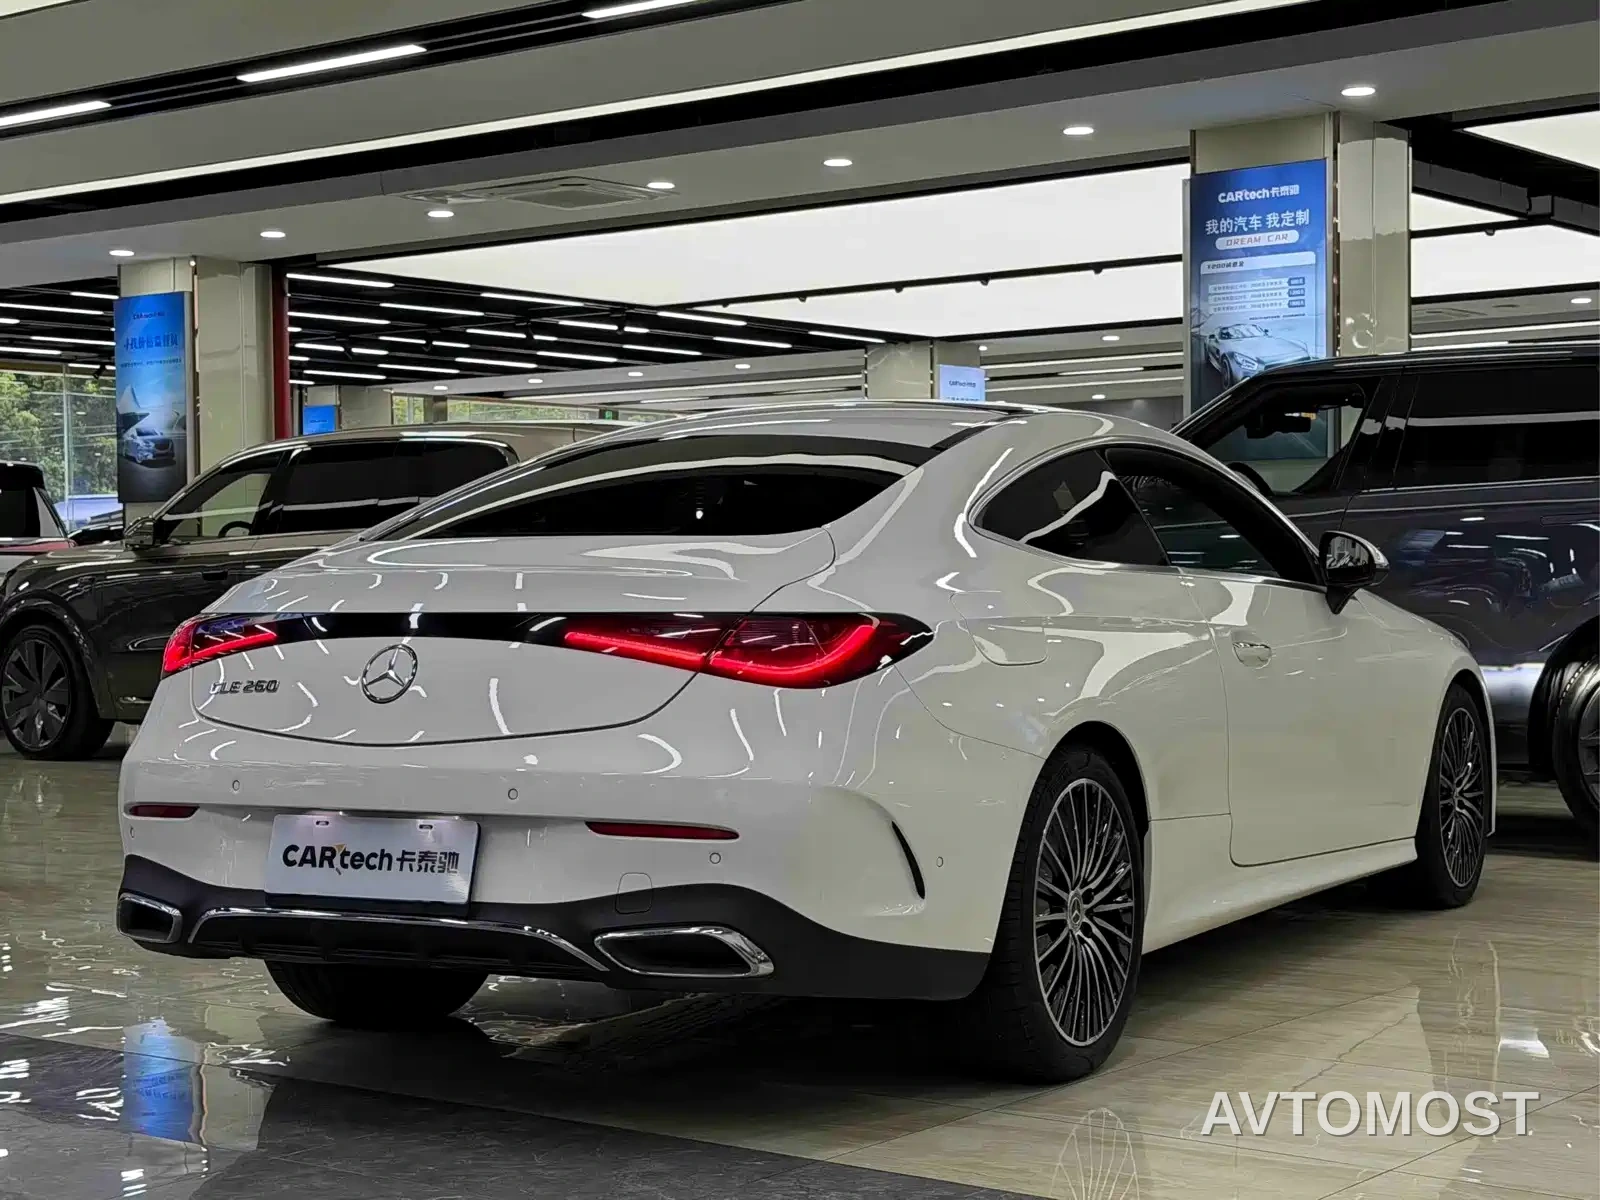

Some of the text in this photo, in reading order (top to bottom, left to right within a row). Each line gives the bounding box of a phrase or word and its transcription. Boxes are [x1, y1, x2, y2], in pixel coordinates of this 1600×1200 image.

[1205, 209, 1310, 235] 我的汽车 我定制
[1226, 234, 1289, 247] DREAM CAR
[243, 680, 280, 693] 260
